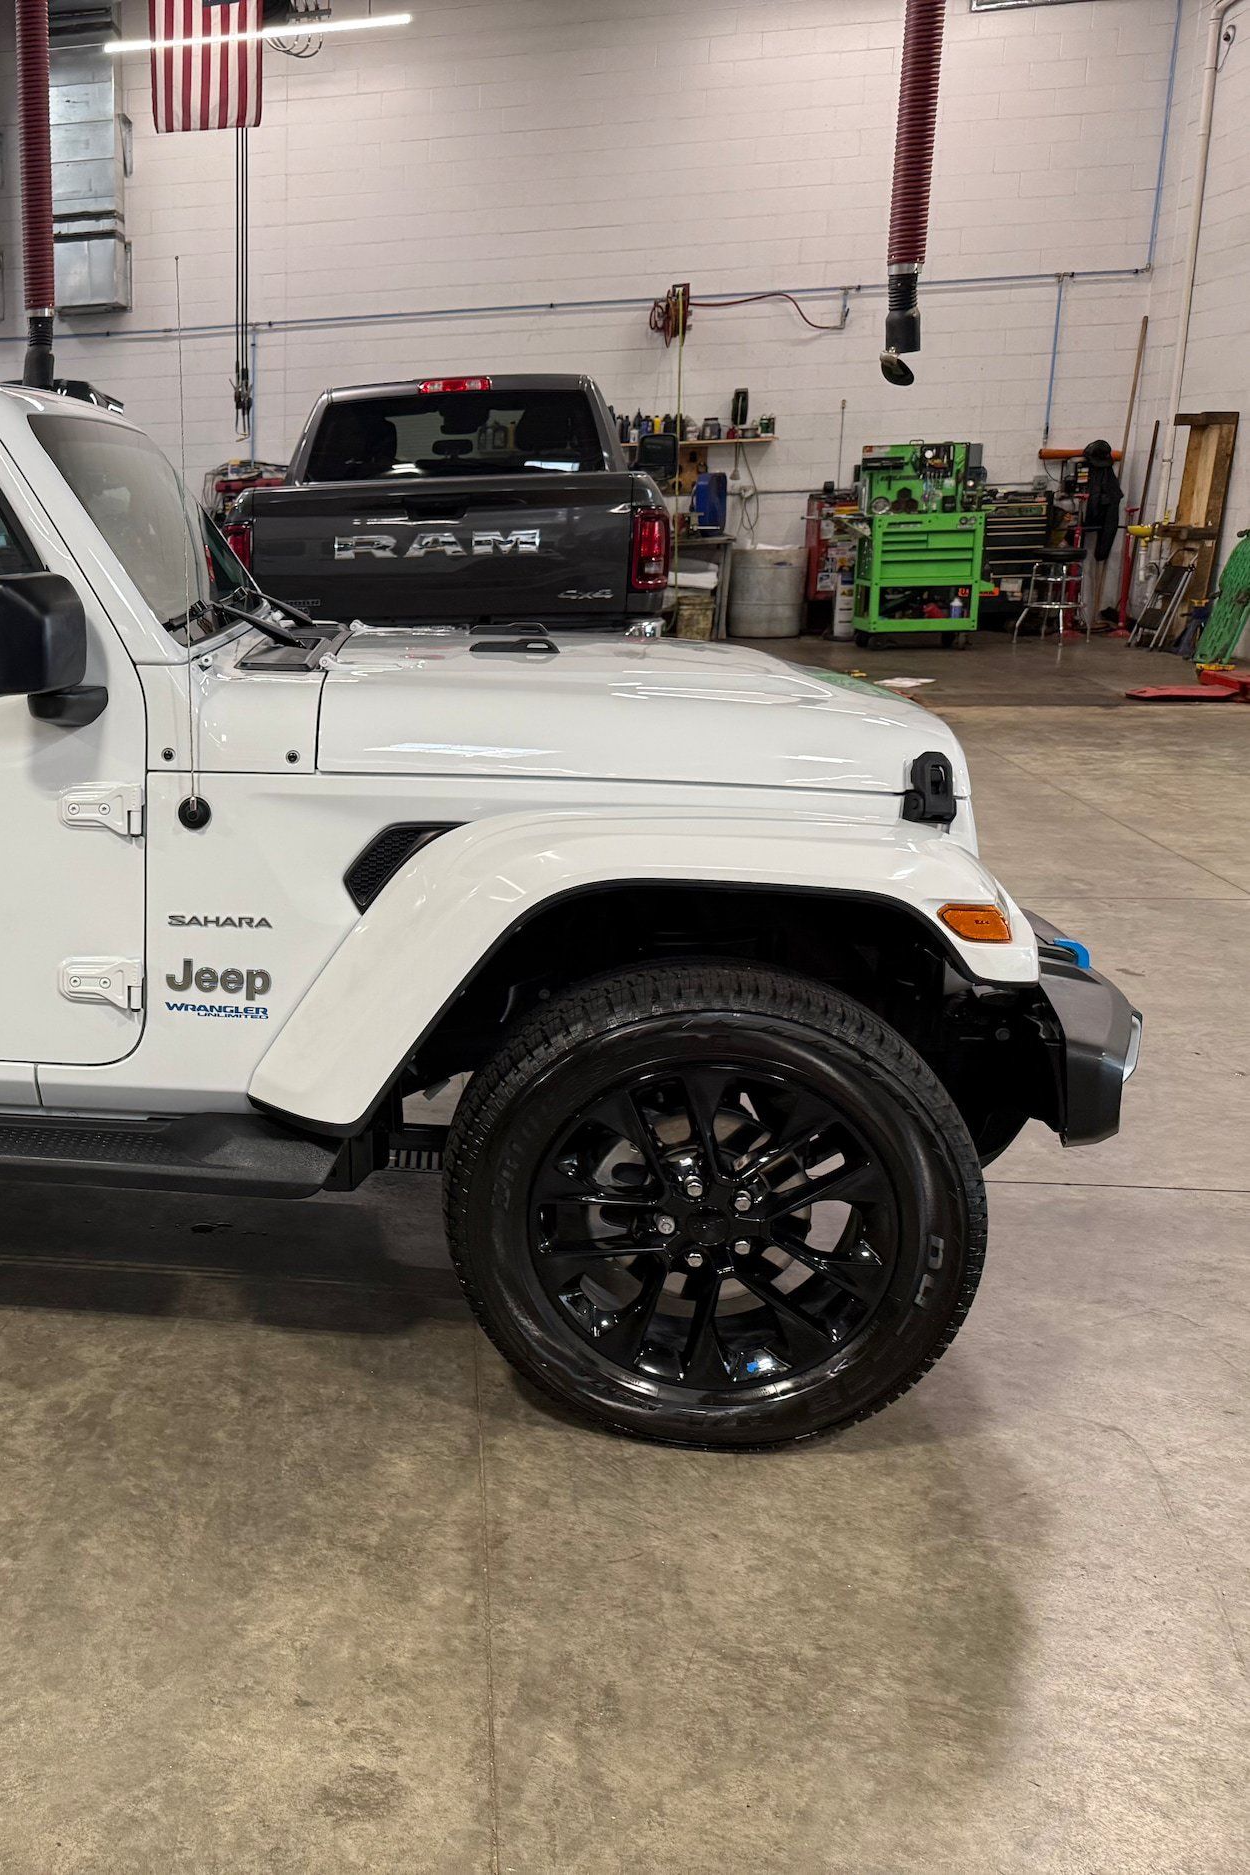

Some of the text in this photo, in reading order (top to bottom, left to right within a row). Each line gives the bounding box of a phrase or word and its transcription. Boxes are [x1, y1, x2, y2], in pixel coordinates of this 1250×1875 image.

[334, 529, 540, 560] RAM
[168, 915, 272, 928] SAHARA
[166, 958, 272, 1001] Jeep
[165, 1002, 268, 1014] WRANGLER
